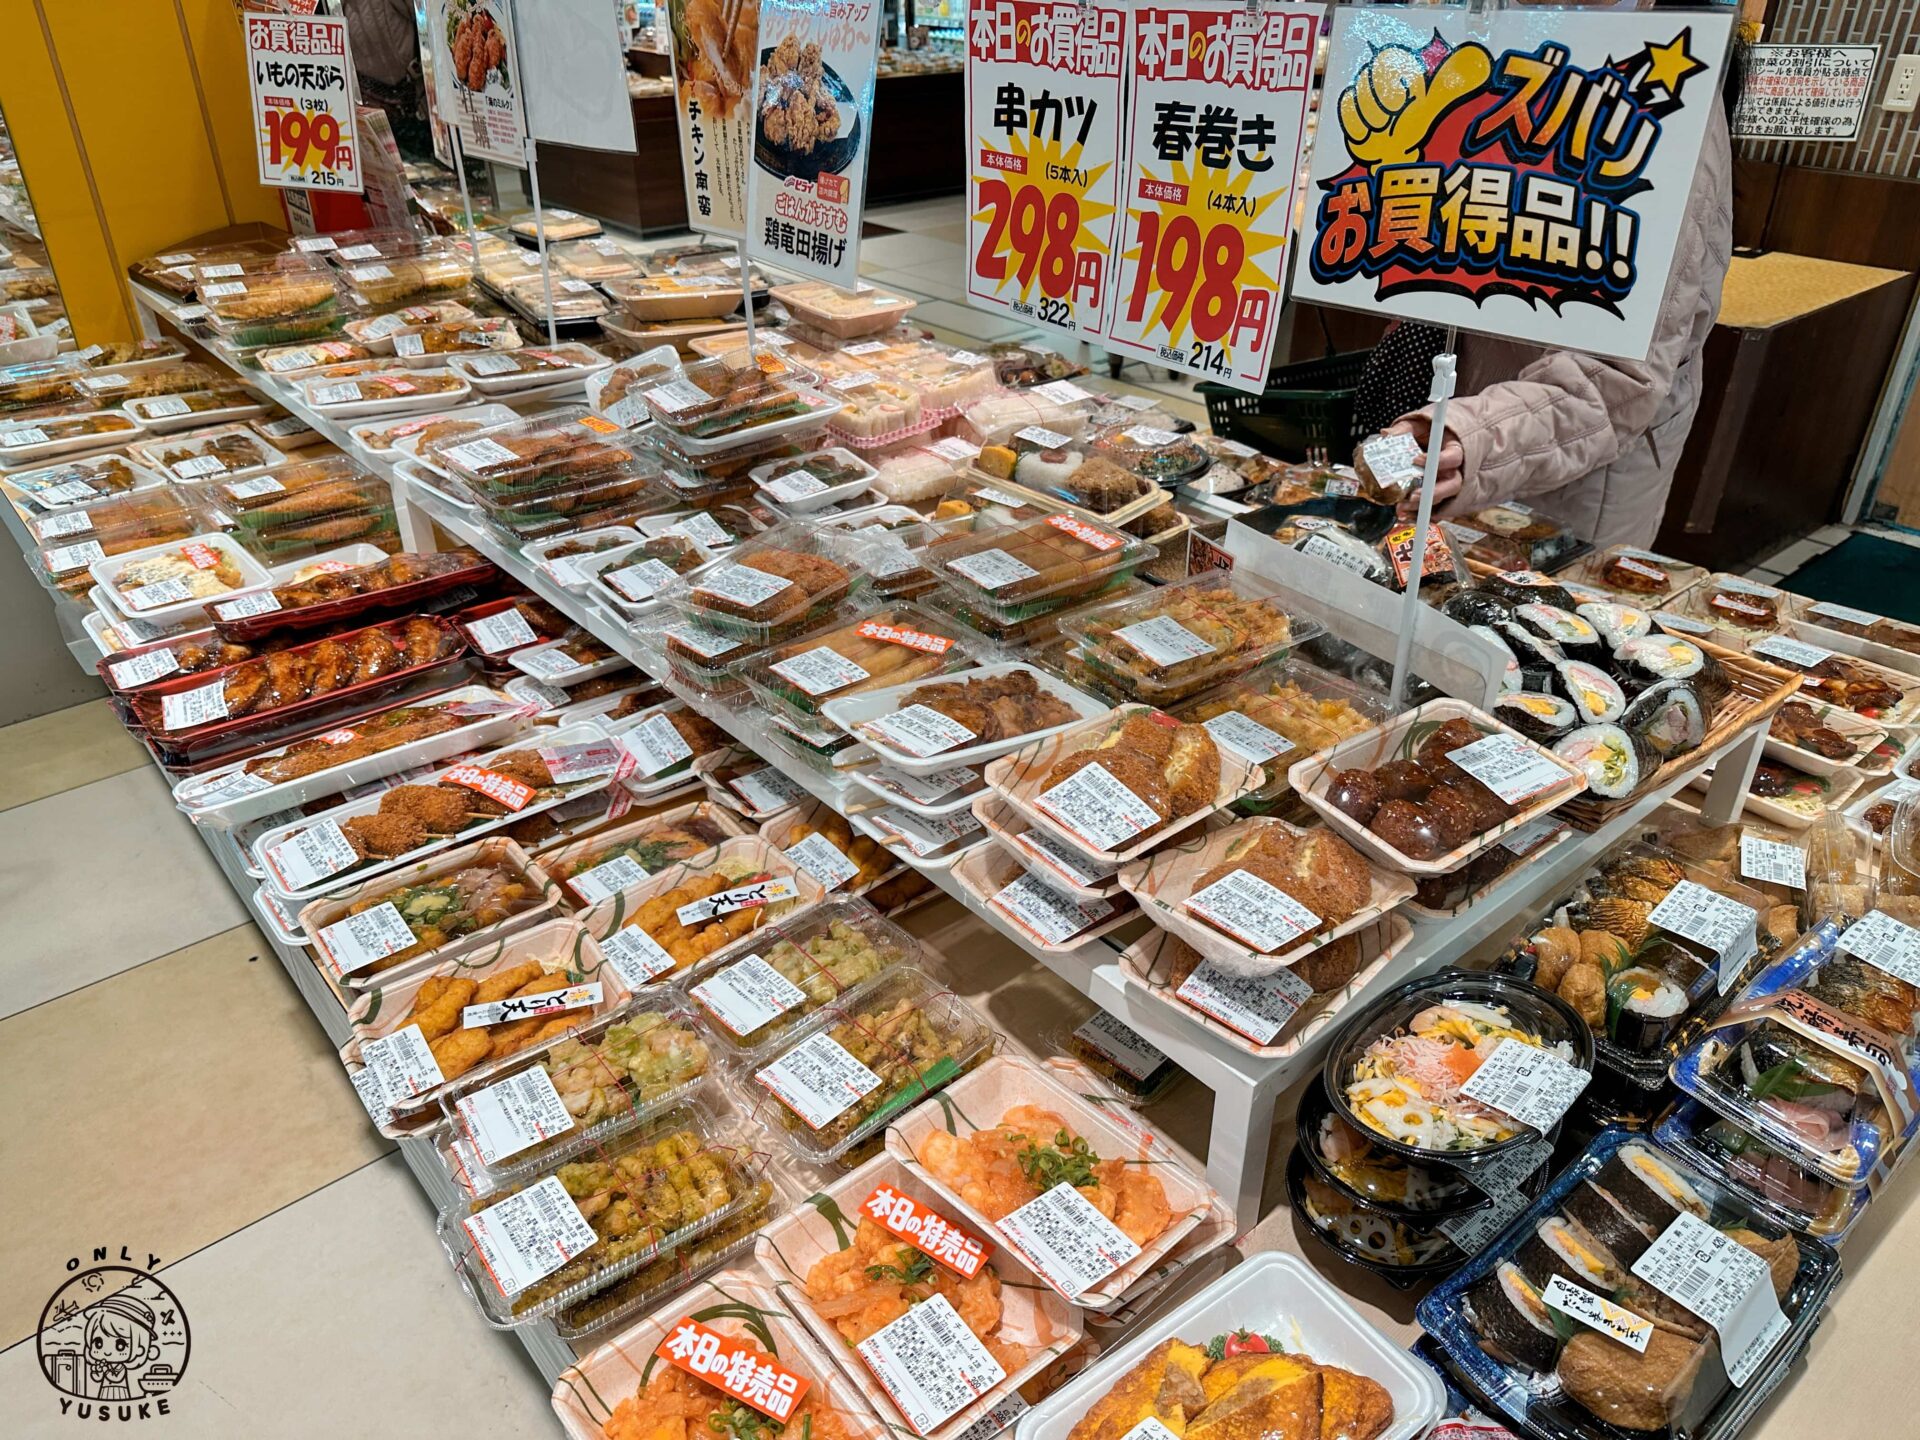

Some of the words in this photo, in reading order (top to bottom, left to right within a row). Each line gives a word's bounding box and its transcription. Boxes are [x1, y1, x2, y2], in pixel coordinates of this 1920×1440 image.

[251, 20, 343, 54] お買得品!!
[971, 2, 1120, 74] 本日のお買得品
[1139, 12, 1309, 89] 本日のお買得品
[257, 61, 344, 91] いもの天ぷら
[301, 98, 328, 111] (3枚)
[994, 82, 1098, 146] 串カツ
[1472, 42, 1661, 180] ズバリ
[265, 111, 353, 170] 199円
[689, 101, 711, 216] チキン南蛮
[1152, 102, 1277, 172] 春巻き
[312, 171, 343, 186] 215円
[986, 154, 1022, 170] 本体価格
[1045, 161, 1088, 188] (5本入)
[775, 192, 848, 234] ごはんがすすむ
[1145, 183, 1182, 201] 本体価格
[1207, 190, 1256, 218] (4本入)
[1320, 166, 1633, 280] お買得品!!
[765, 217, 847, 268] 鶏竜田揚げ
[975, 179, 1102, 308] 298円
[1127, 211, 1271, 352] 198円
[1037, 297, 1076, 331] 322円
[1188, 341, 1232, 379] 214円
[859, 623, 946, 652] 本日の特売品
[447, 767, 528, 808] 本日の特売品
[709, 884, 765, 915] とり天
[500, 989, 569, 1021] とり天
[545, 1181, 594, 1244] おつまみイカ磯辺天
[866, 1189, 983, 1276] 本日の特売品
[1062, 1187, 1133, 1250] エビチリソース
[1639, 1220, 1693, 1273] 特上助六寿司
[935, 1300, 999, 1375] エビチリソース
[667, 1322, 799, 1418] 本日の特売品
